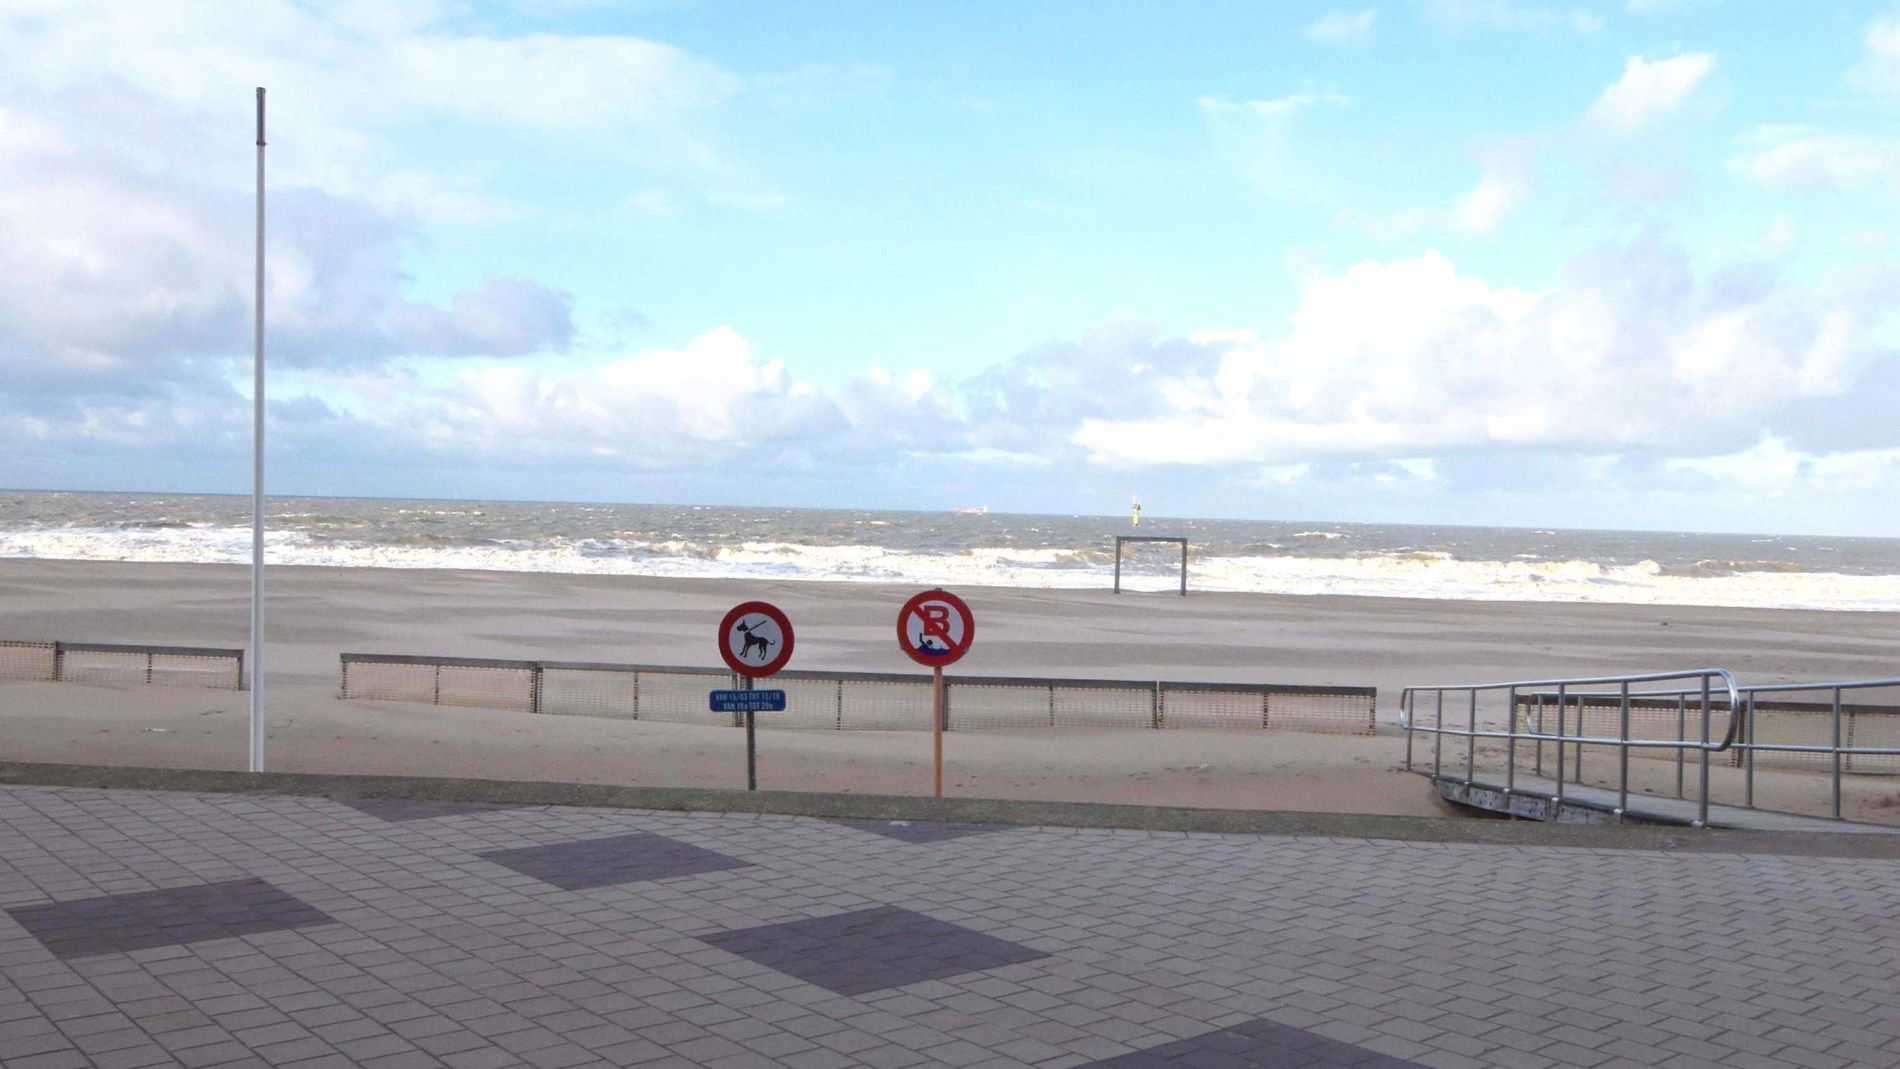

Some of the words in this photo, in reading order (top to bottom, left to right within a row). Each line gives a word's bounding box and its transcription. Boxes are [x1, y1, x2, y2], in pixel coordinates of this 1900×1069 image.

[715, 693, 728, 701] VAN
[749, 692, 760, 701] TOT
[723, 702, 736, 710] VAN
[749, 702, 760, 710] TOT
